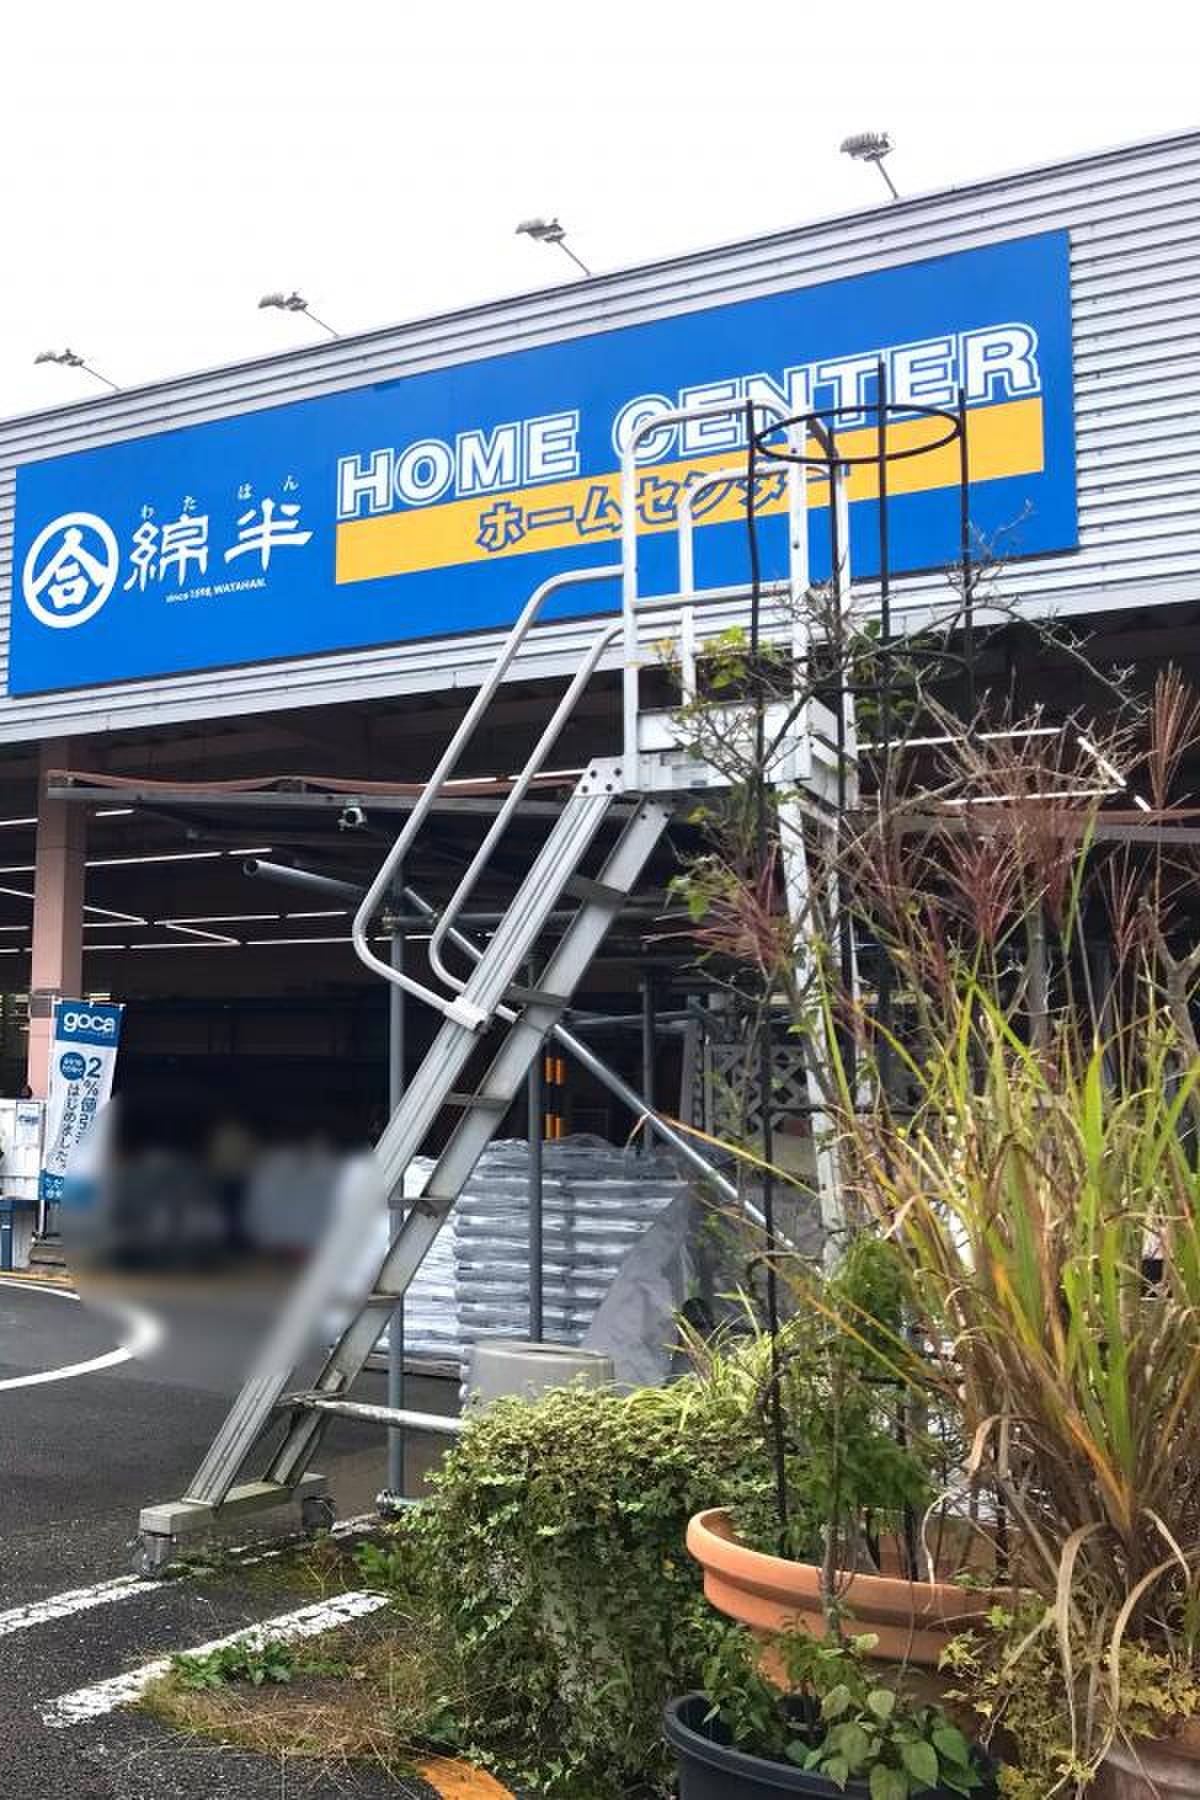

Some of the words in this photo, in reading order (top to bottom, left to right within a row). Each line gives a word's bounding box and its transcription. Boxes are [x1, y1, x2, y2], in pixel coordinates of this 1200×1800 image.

[337, 410, 580, 520] HOME
[611, 321, 1041, 465] CENTER
[123, 498, 313, 592] 綿半
[63, 1012, 115, 1033] goca
